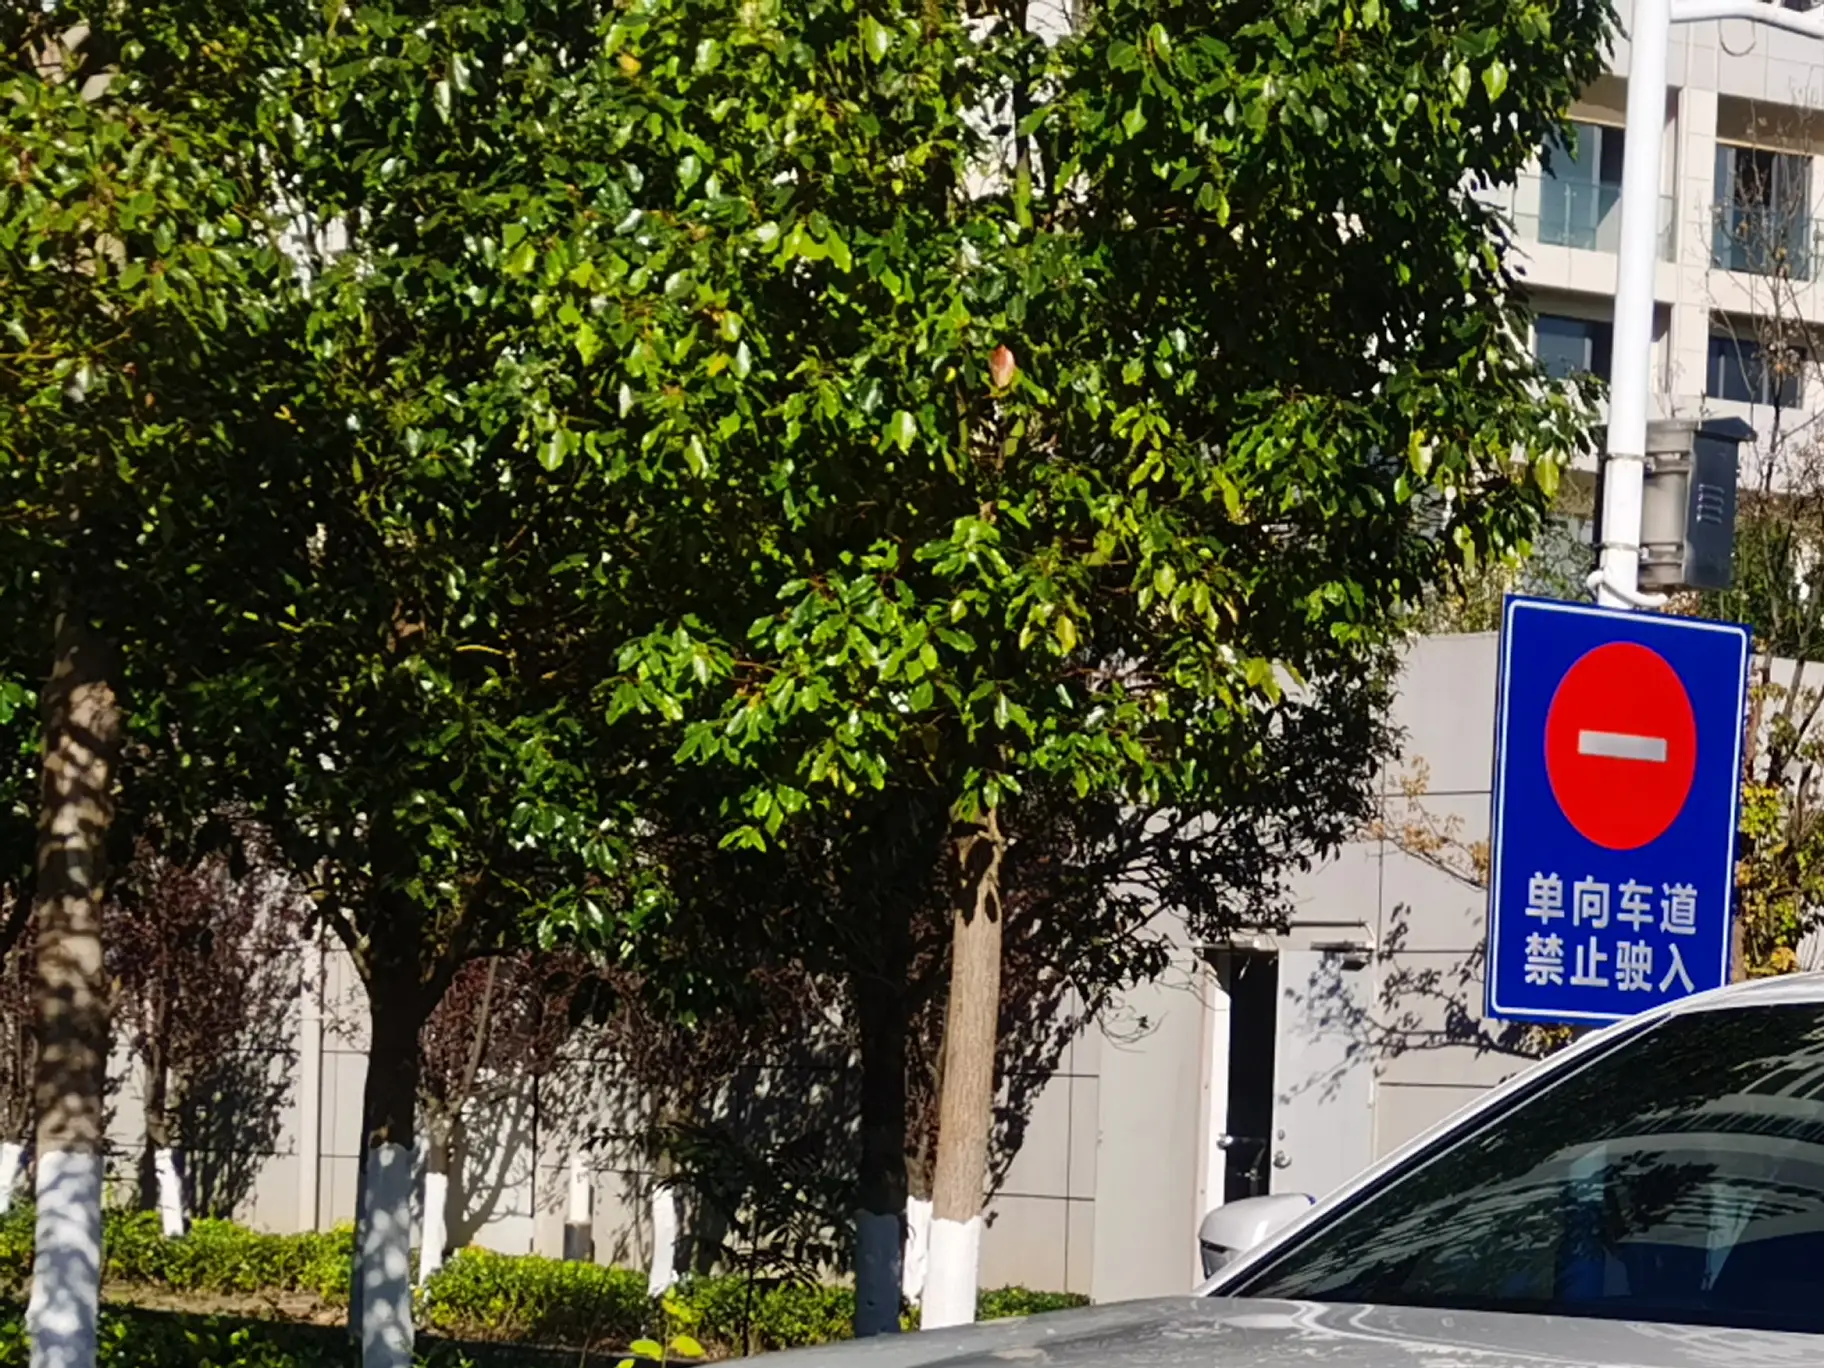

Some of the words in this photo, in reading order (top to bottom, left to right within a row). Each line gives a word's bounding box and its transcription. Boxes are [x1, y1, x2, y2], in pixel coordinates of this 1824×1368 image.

[1525, 871, 1697, 934] 单向车道
[1524, 931, 1695, 993] 禁止驶入
